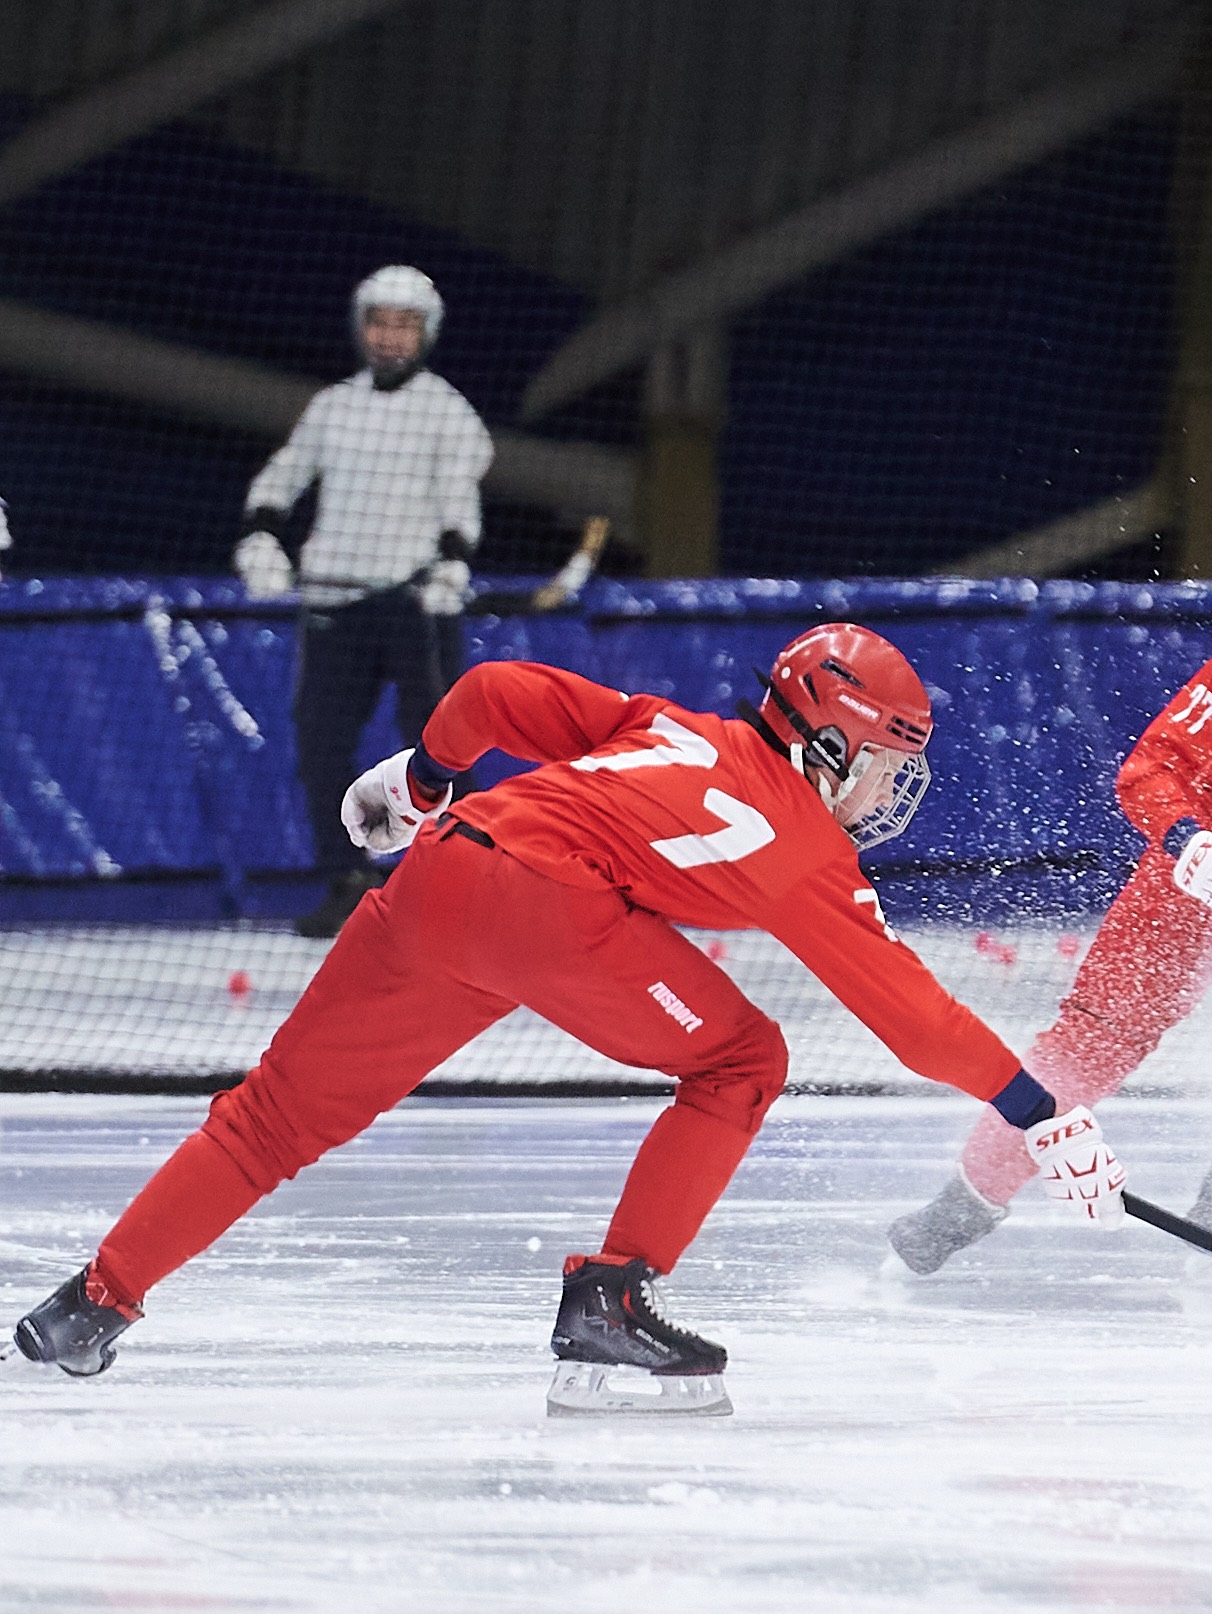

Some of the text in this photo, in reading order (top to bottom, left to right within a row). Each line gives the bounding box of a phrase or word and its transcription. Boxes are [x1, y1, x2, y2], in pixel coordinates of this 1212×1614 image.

[569, 712, 776, 869] 77
[647, 981, 704, 1034] rusport
[1036, 1118, 1094, 1153] STEX
